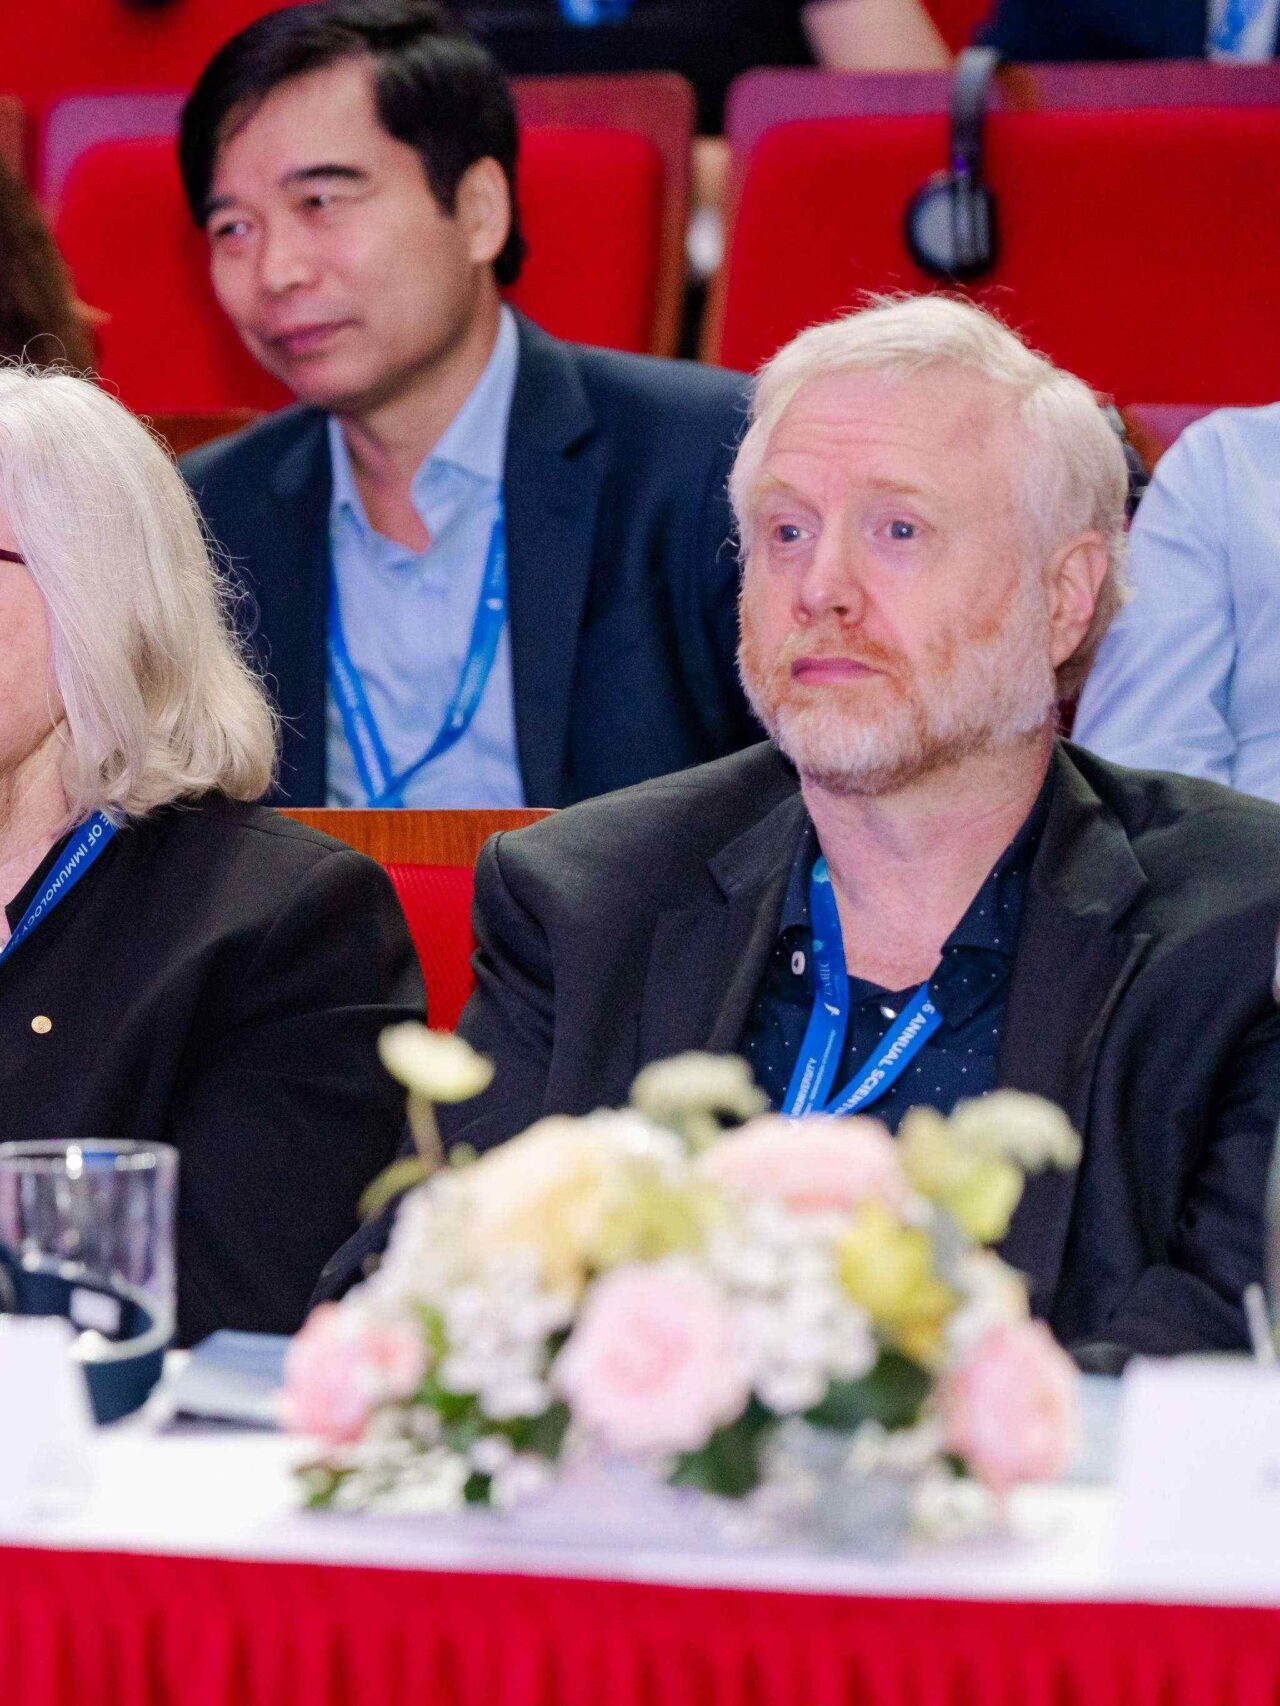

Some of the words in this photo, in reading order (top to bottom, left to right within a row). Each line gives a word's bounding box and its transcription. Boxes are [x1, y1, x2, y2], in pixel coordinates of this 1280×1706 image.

[87, 824, 103, 847] OF
[22, 843, 88, 935] IMMUNOLOGY
[878, 1012, 927, 1067] ANNUAL
[834, 1068, 886, 1115] SCIENT
